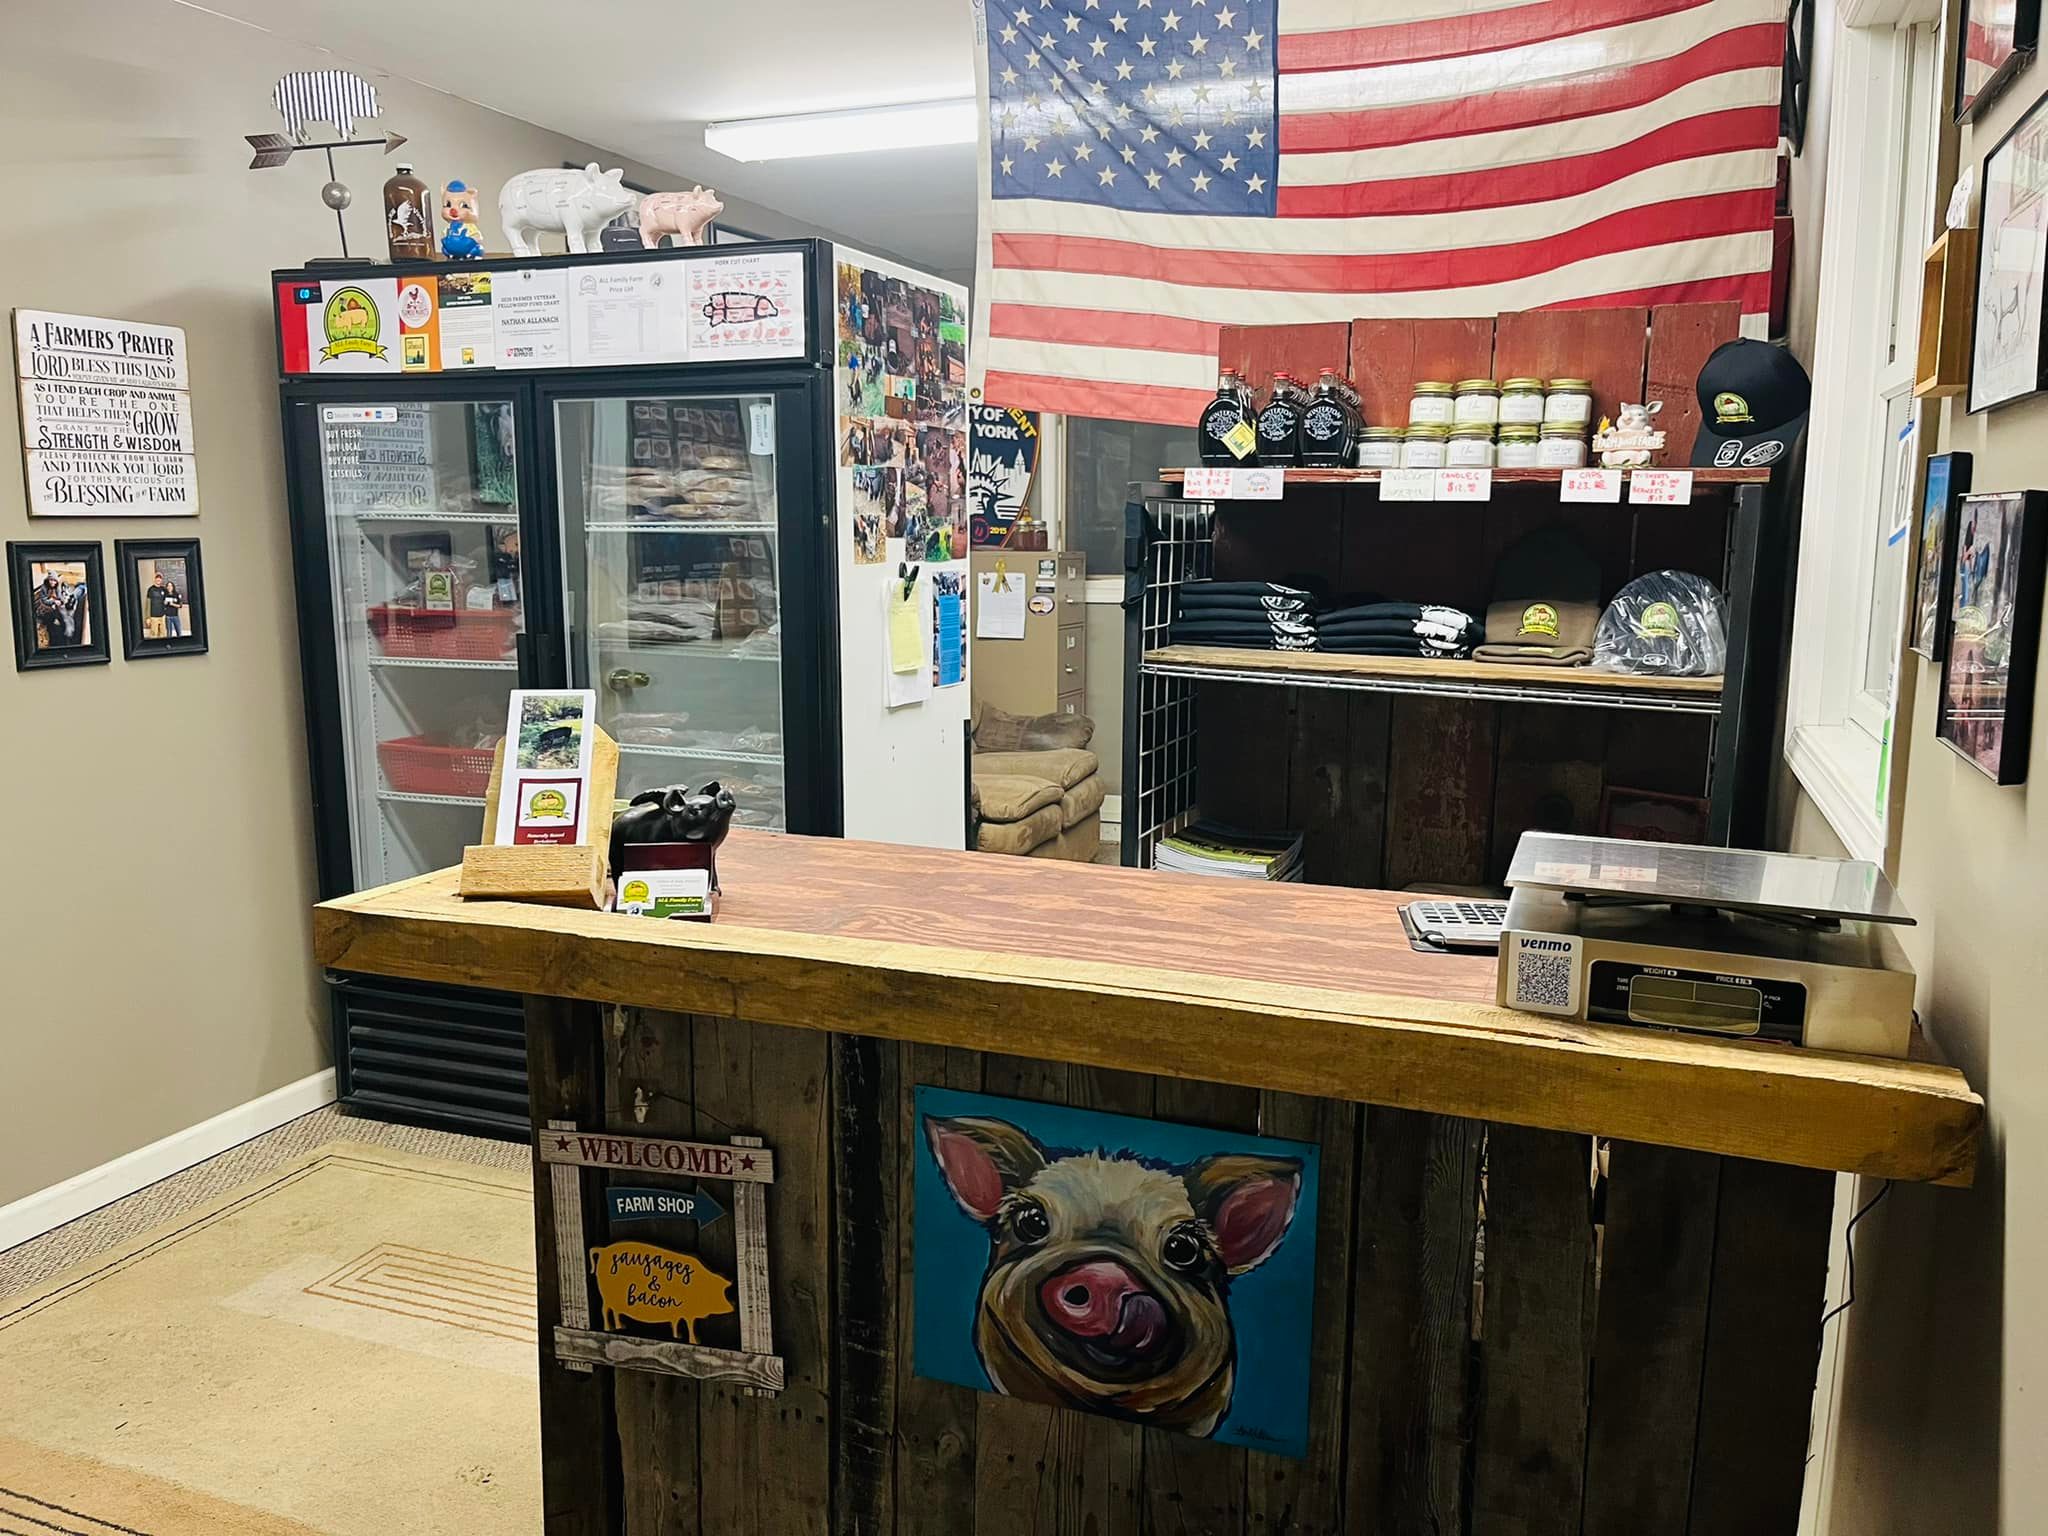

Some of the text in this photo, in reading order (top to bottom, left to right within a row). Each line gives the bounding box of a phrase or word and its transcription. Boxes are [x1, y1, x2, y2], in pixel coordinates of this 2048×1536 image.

[31, 322, 174, 356] A FARMERS PRAYER
[72, 357, 110, 374] BLESS
[112, 361, 142, 377] THIS
[145, 363, 176, 380] LAND
[34, 383, 176, 401] AS I TEND EACH CROP AND ANIMAL
[34, 393, 178, 412] YOU'RE THE ONE
[36, 405, 179, 436] THAT HELPS THEM GROW
[983, 407, 1005, 422] OF
[1306, 406, 1341, 419] WINTERTON
[55, 423, 89, 431] GRANT
[326, 430, 338, 439] BUY
[975, 424, 1019, 441] YORK
[38, 425, 181, 451] STRENGTH & WISDOM
[42, 460, 183, 477] AND THANK YOU LORD
[1579, 471, 1602, 479] CAPS
[46, 476, 133, 506] BLESSING
[149, 487, 185, 502] FARM
[1520, 937, 1572, 952] venmo
[1643, 967, 1667, 976] WEIGHT
[1715, 975, 1735, 984] PRICE
[577, 1136, 734, 1176] WELCOME
[616, 1196, 695, 1215] FARM SHOP
[610, 1251, 694, 1284] sausages
[648, 1275, 661, 1292] &
[626, 1284, 683, 1308] bacon
